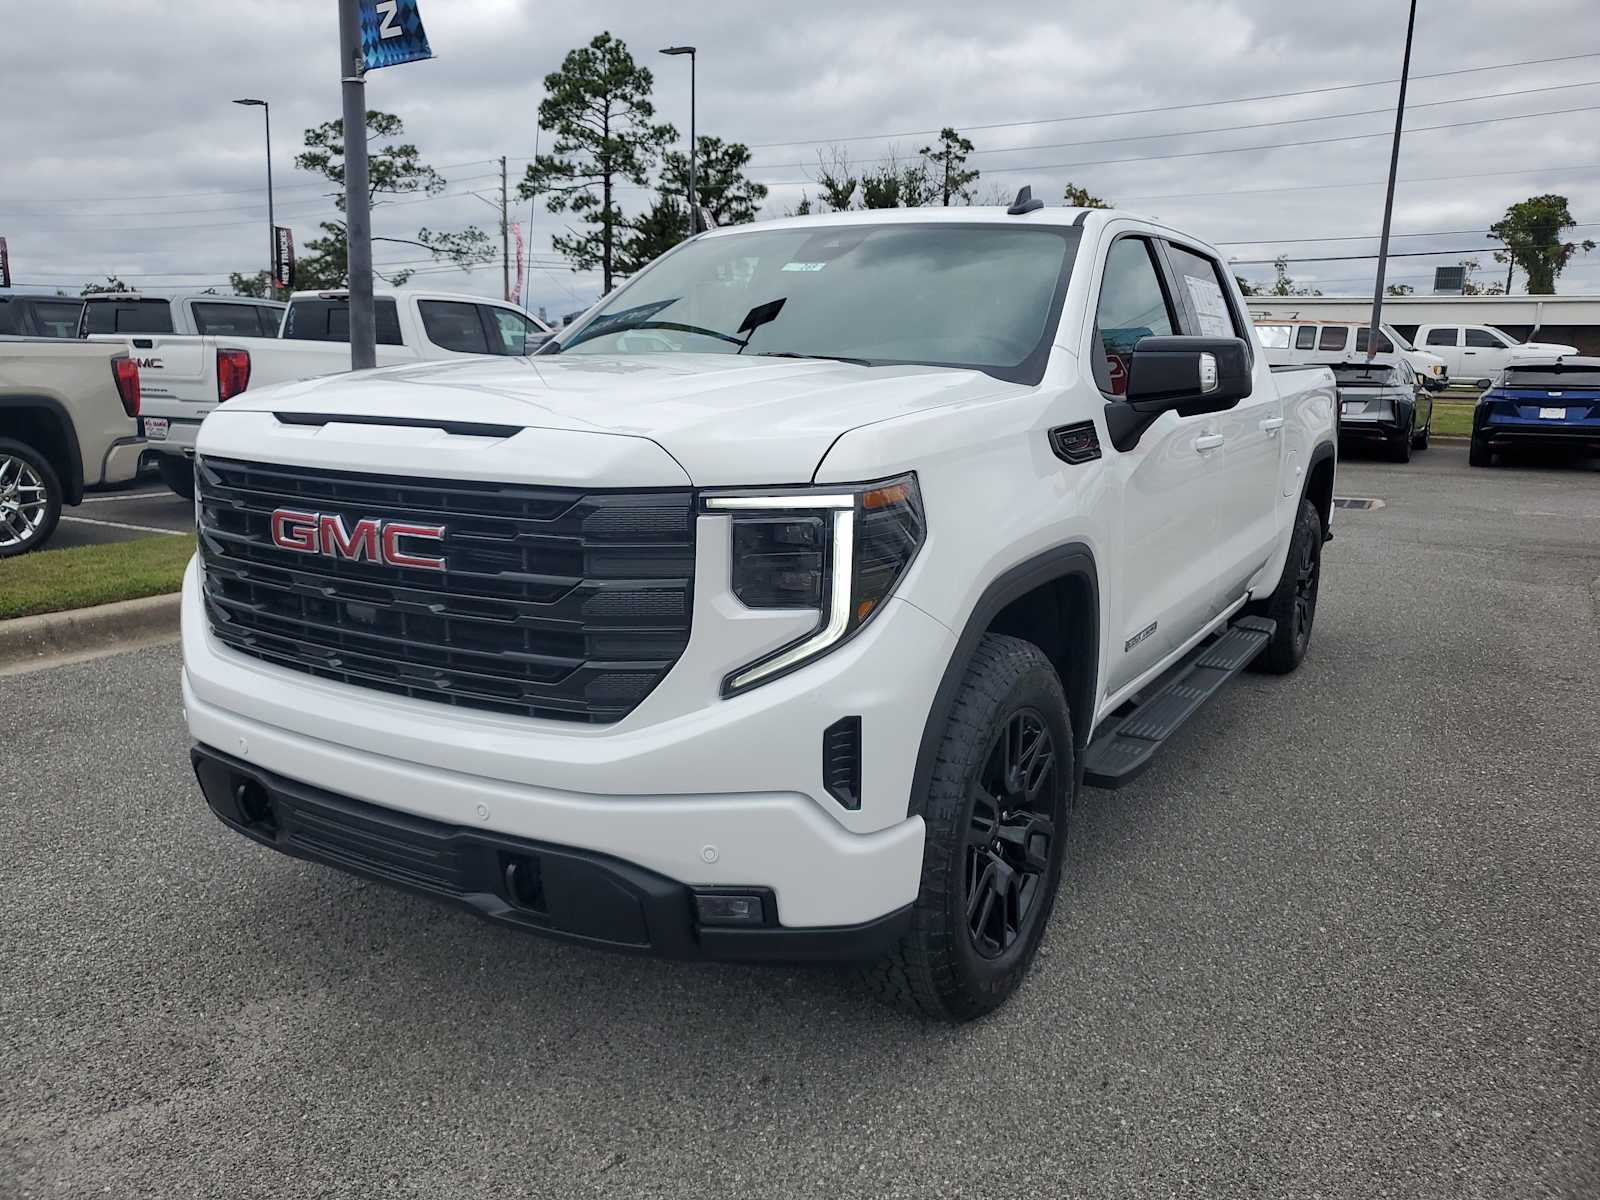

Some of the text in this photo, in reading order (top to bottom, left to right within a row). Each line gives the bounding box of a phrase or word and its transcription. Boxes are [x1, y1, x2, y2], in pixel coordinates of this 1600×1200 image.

[280, 230, 289, 263] TRUCKS
[137, 358, 164, 369] MC
[271, 508, 447, 572] GMC
